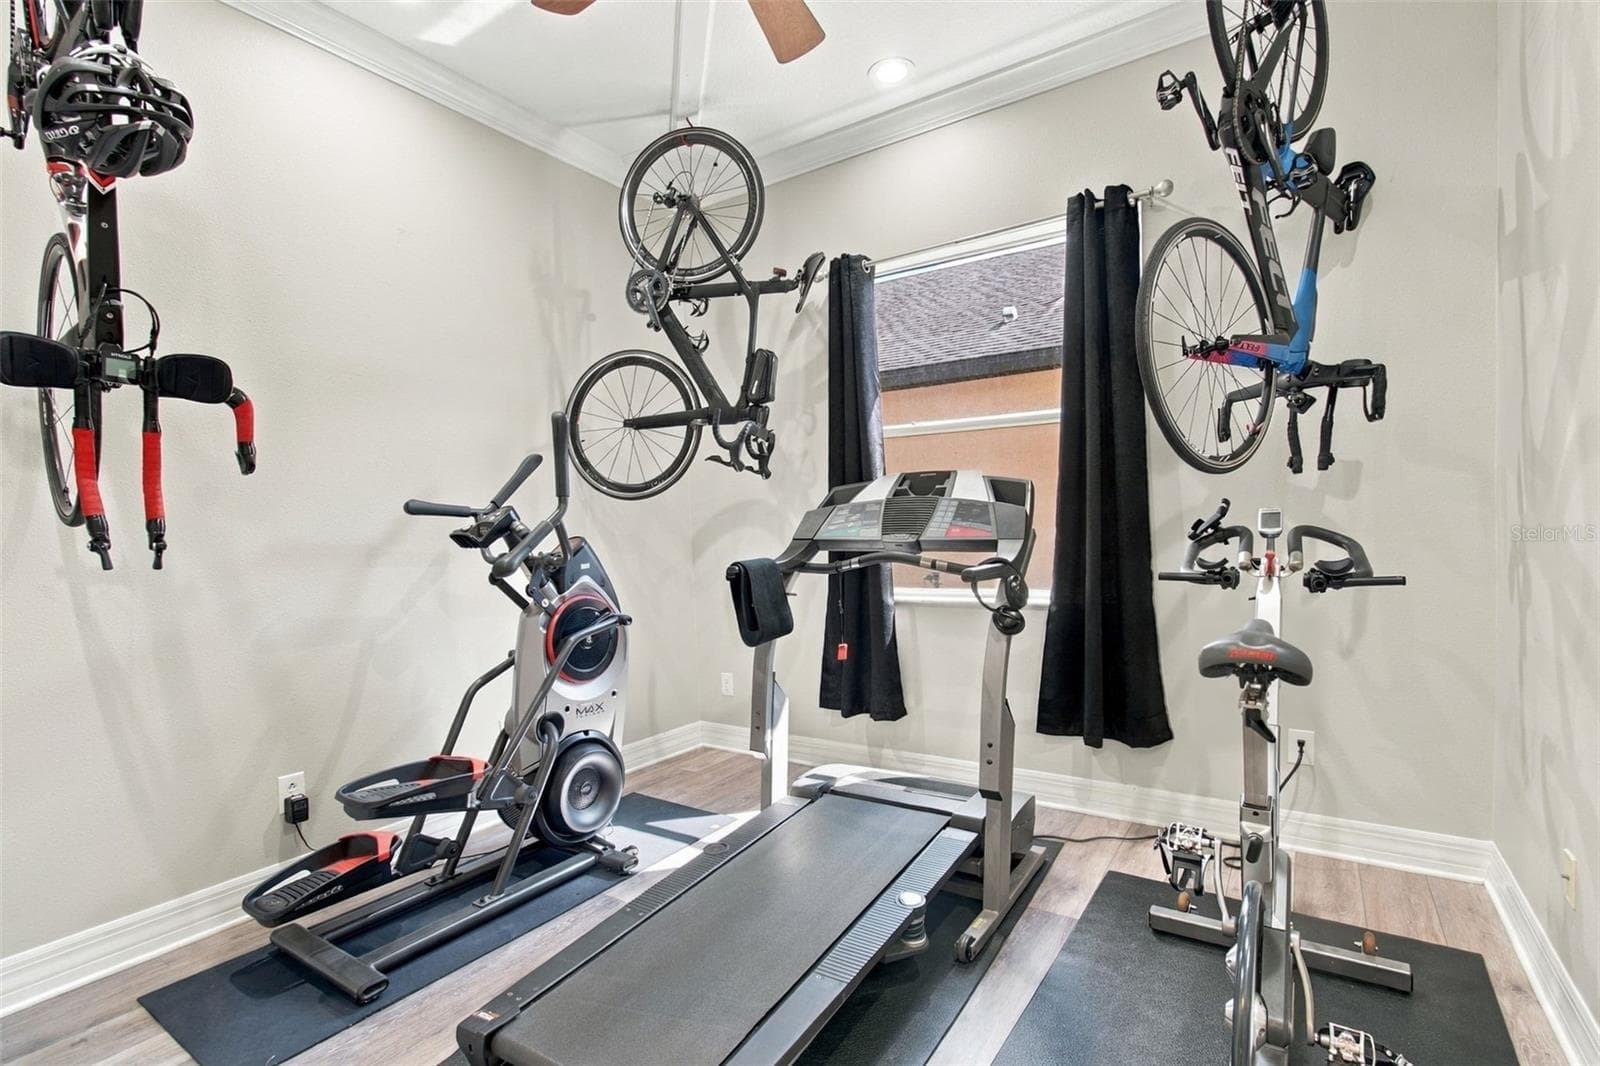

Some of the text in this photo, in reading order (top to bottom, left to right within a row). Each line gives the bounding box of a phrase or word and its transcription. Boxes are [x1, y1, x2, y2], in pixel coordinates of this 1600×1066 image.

[1226, 146, 1253, 216] FELT
[1251, 187, 1291, 309] FELT
[576, 702, 604, 715] MAX
